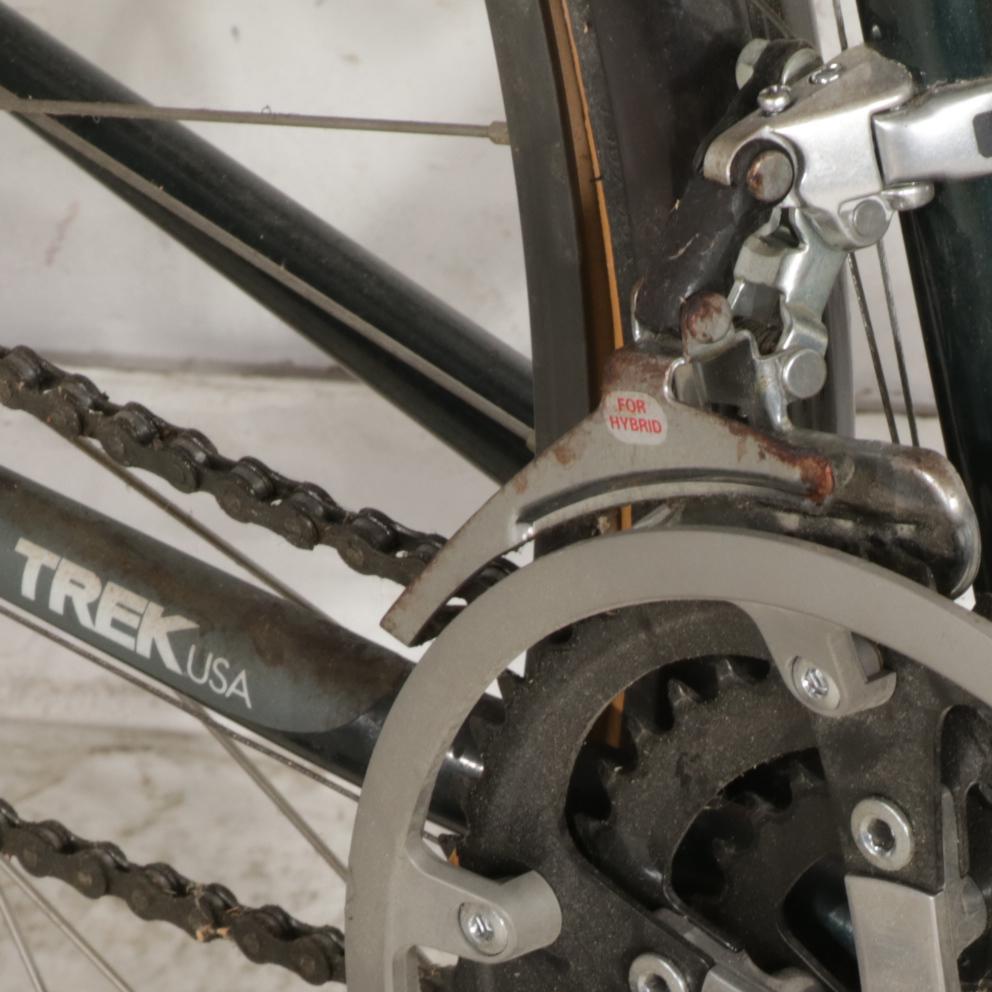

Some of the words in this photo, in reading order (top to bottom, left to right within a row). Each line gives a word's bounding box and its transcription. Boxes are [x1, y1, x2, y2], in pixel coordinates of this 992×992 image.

[617, 397, 646, 413] FOR
[608, 415, 662, 433] HYBRID
[15, 537, 200, 676] TREK
[186, 644, 252, 709] USA
